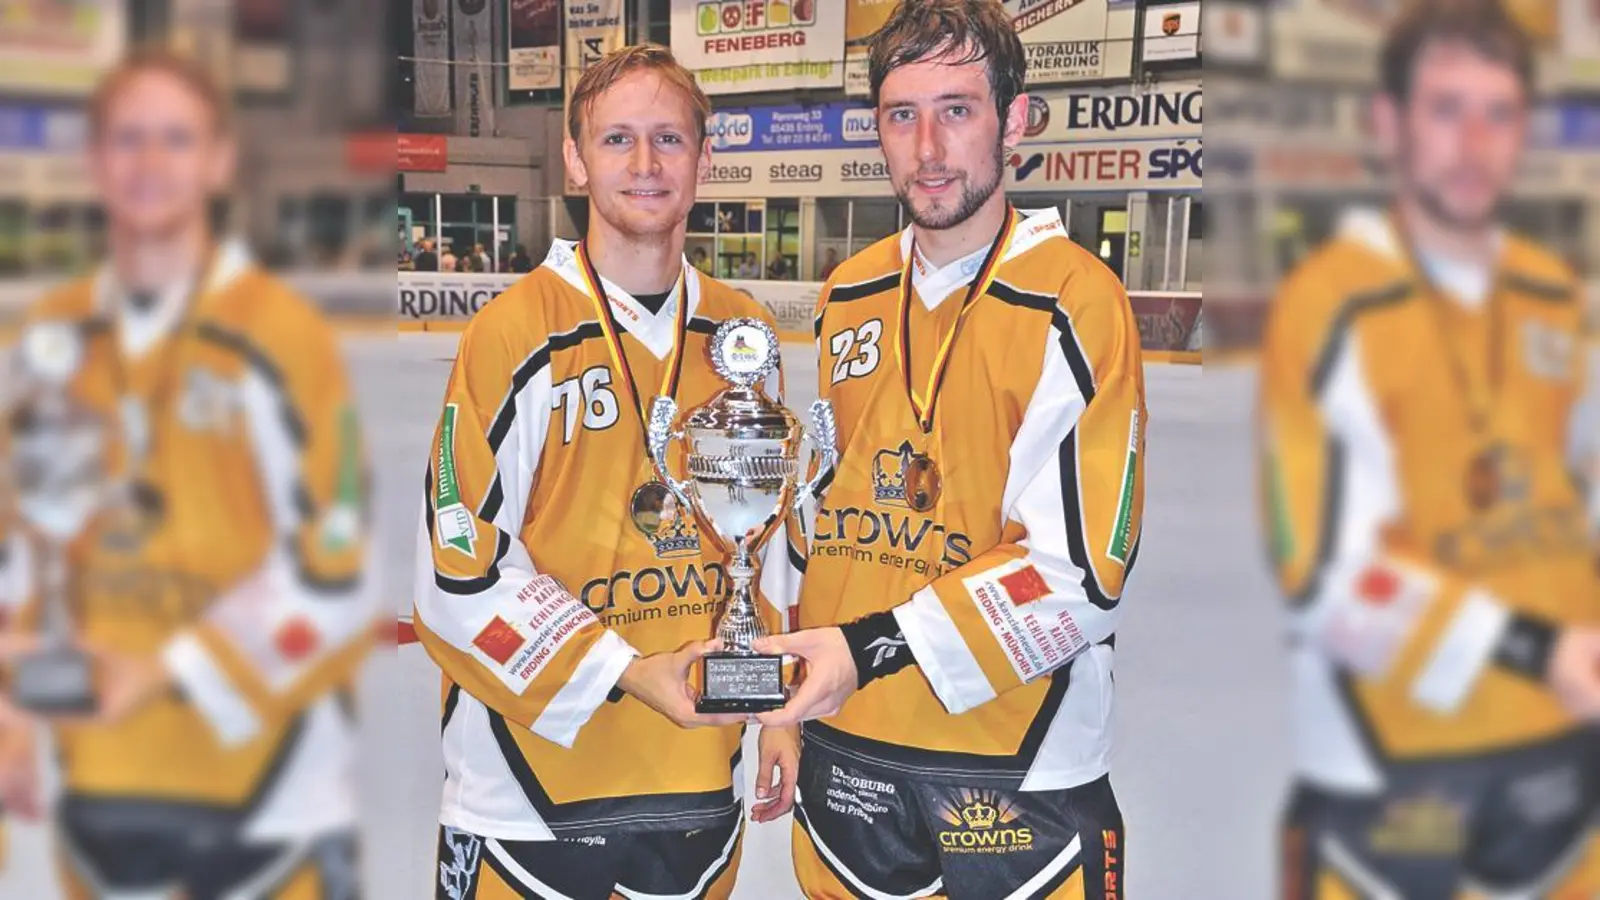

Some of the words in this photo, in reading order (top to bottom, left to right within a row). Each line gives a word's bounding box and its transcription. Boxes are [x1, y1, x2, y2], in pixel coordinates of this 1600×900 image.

[704, 31, 806, 54] FENEBERG
[1027, 41, 1099, 57] YDRAULIK
[1026, 55, 1100, 69] ENERDING
[769, 163, 822, 182] steag
[1045, 149, 1141, 182] INTER
[830, 318, 884, 388] 23
[551, 365, 620, 445] 76
[975, 587, 1003, 627] ERDING
[1001, 630, 1034, 676] MÜNCHEN
[520, 647, 550, 680] ERDING
[552, 609, 593, 645] MÜNCHEN
[939, 827, 1033, 847] crowns
[1008, 843, 1033, 852] drink
